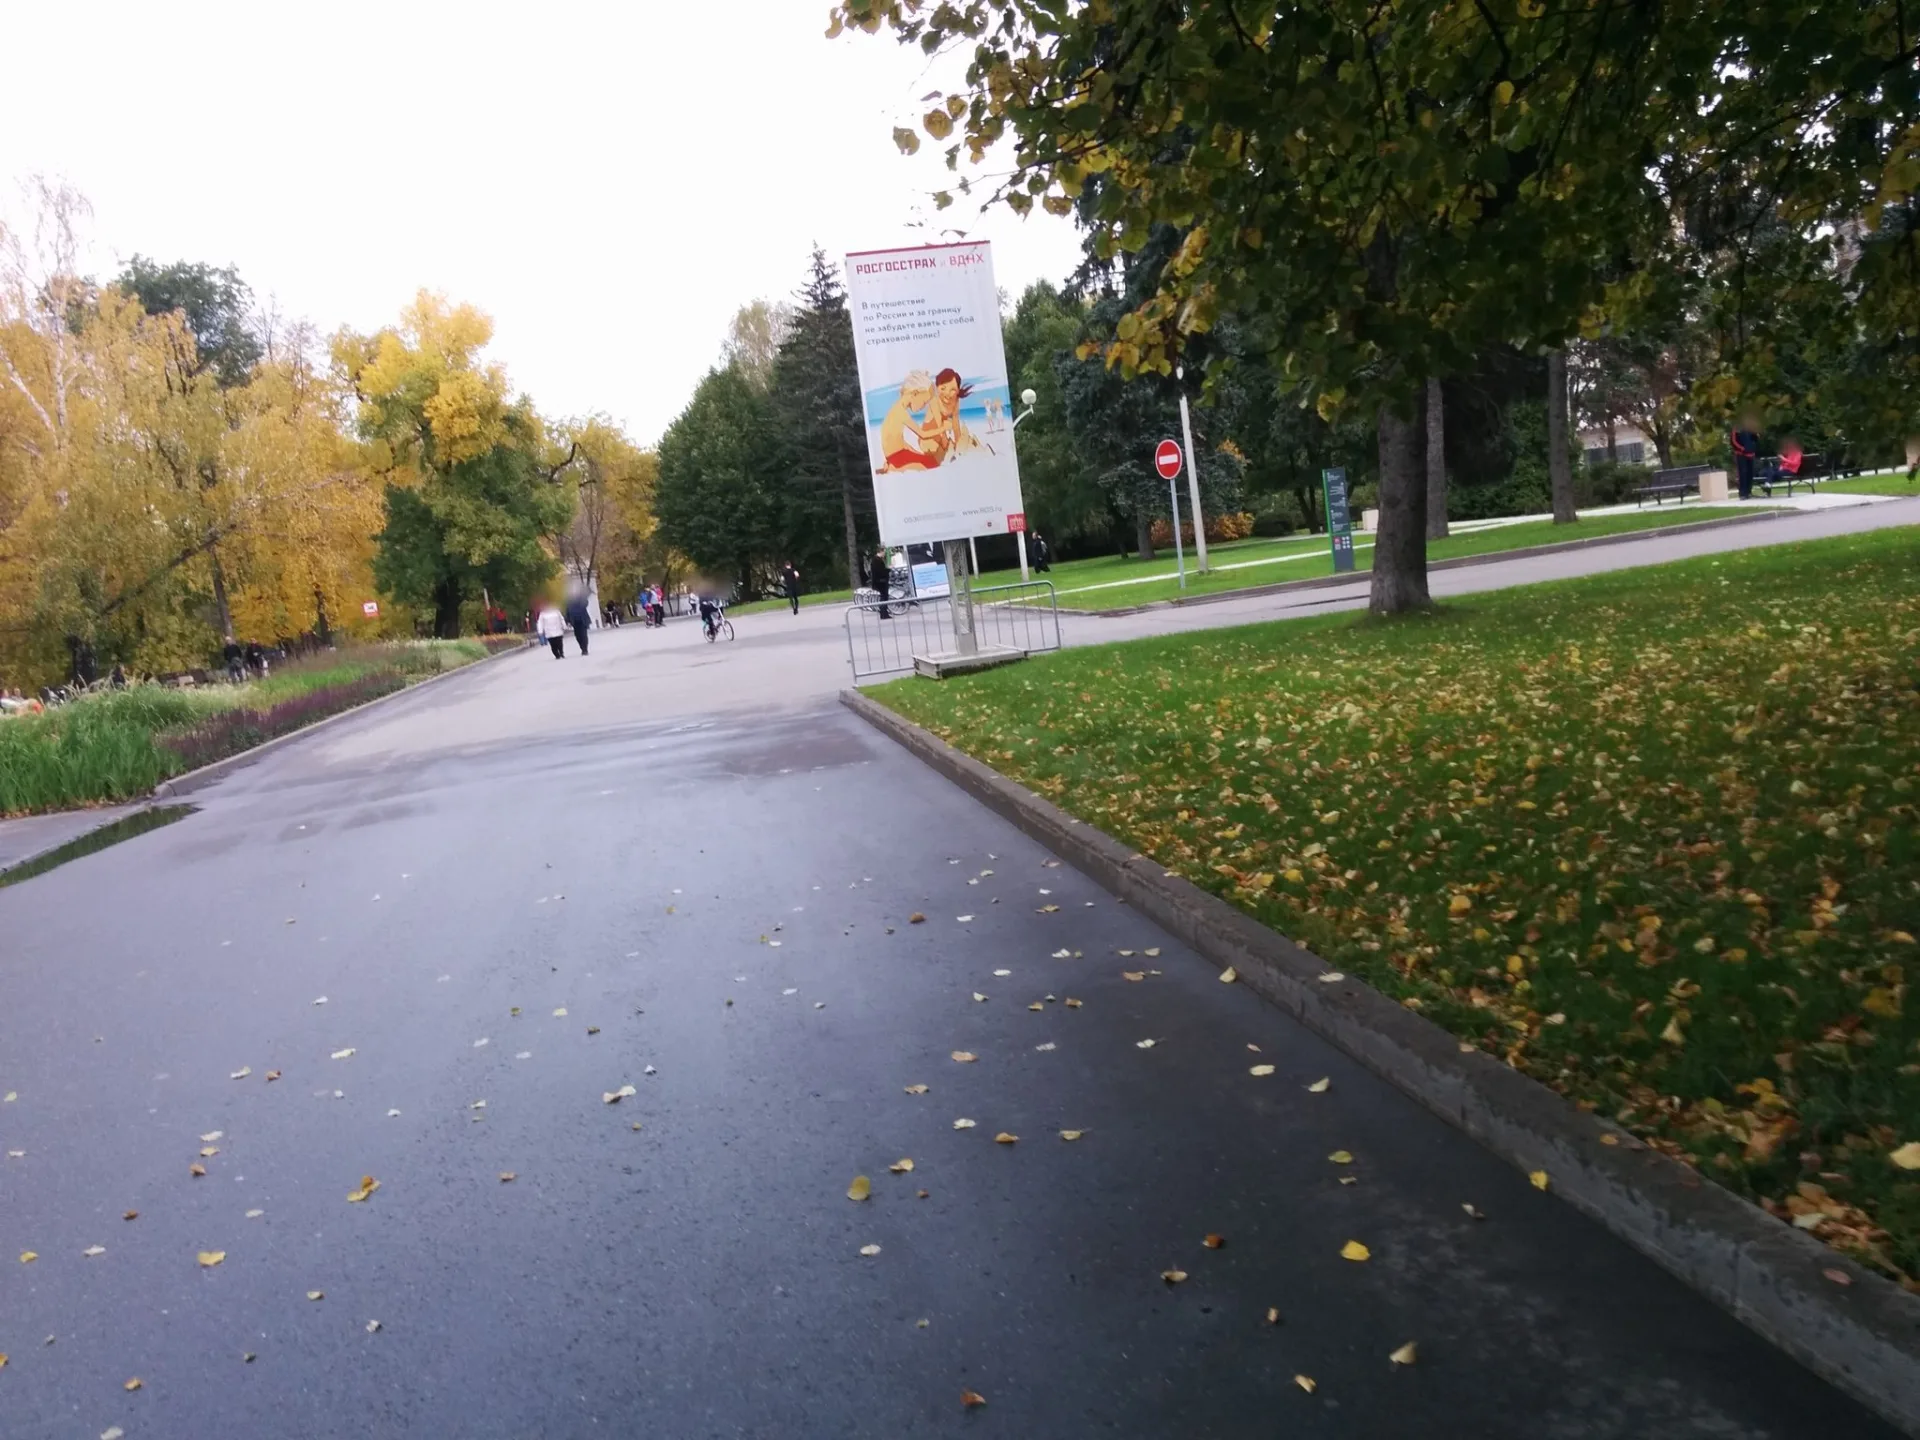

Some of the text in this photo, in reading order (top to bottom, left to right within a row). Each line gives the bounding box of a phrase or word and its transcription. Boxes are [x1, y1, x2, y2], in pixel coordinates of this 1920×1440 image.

[856, 257, 936, 275] РОСГОССТРАХ
[950, 253, 985, 268] ВДНХ
[861, 298, 926, 310] В путешествие
[876, 311, 907, 321] России
[928, 306, 962, 317] границу
[878, 323, 916, 332] забудьте
[917, 321, 941, 329] взять
[949, 316, 975, 325] собой
[866, 330, 941, 346] страховой полис!
